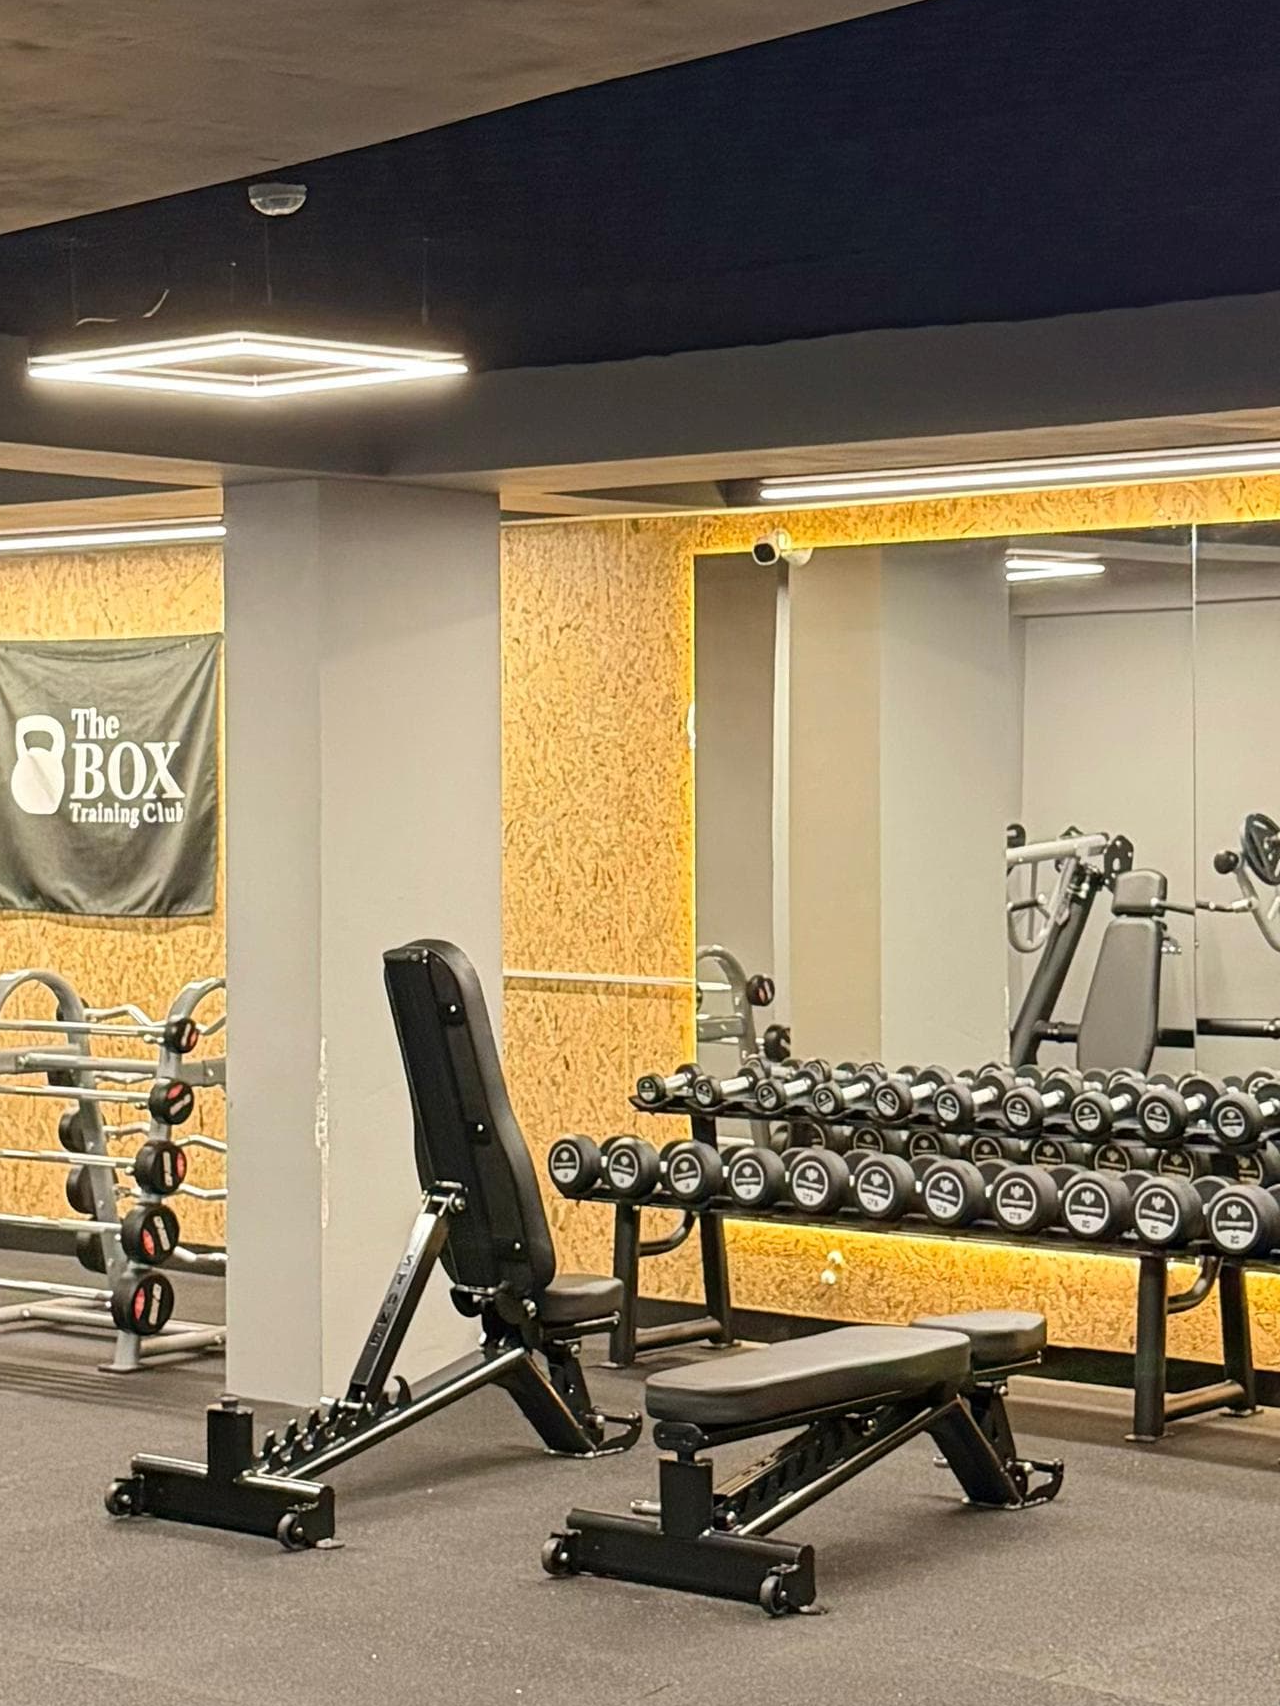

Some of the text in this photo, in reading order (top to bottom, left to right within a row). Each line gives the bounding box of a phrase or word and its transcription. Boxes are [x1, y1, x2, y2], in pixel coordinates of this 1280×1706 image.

[71, 707, 120, 739] The
[70, 741, 186, 801] BOX
[69, 802, 184, 828] Training Club
